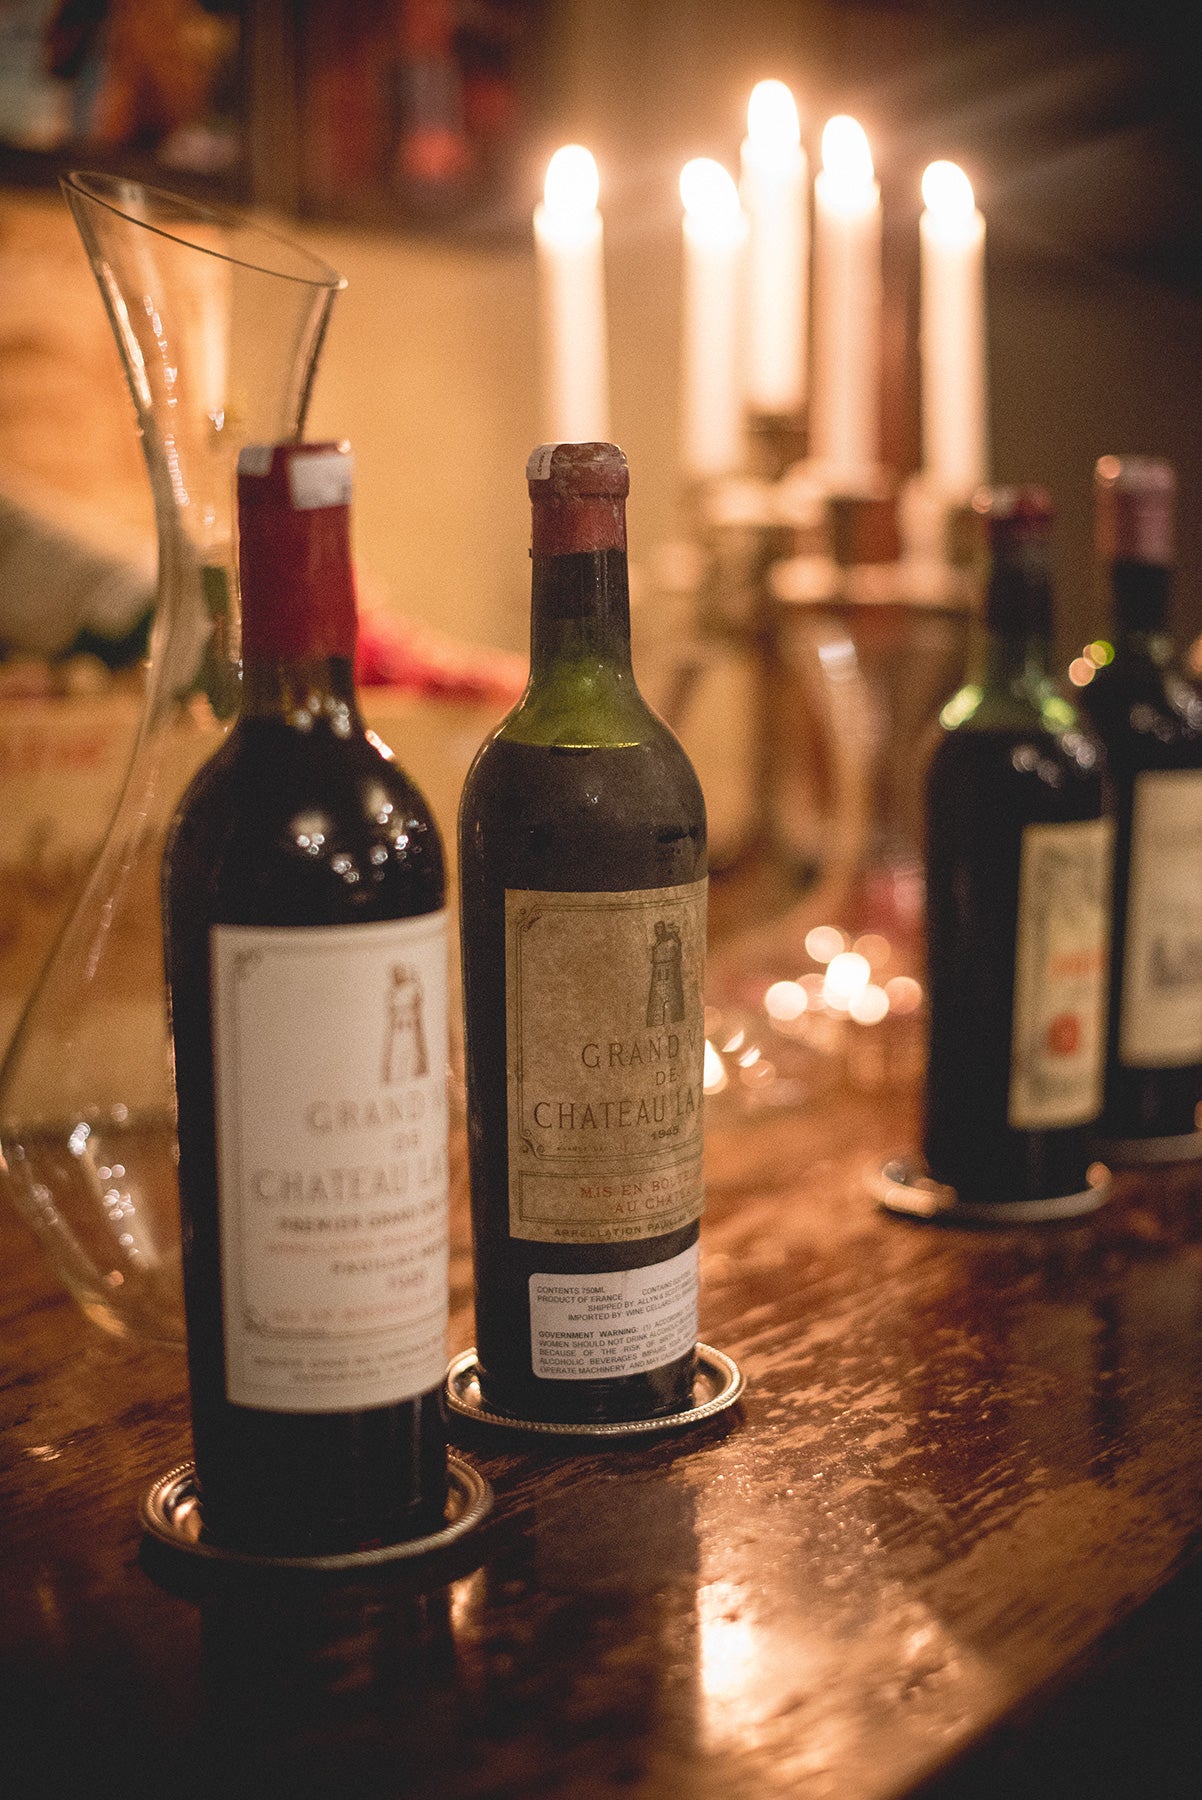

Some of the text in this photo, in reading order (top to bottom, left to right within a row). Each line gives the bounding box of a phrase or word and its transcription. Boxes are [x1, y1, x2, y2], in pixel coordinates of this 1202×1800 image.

[581, 1034, 680, 1069] GRAND
[655, 1067, 679, 1086] DE
[303, 1090, 426, 1134] GRAND
[533, 1093, 666, 1130] CHATEAU
[251, 1163, 408, 1204] CHATEAU
[580, 1186, 613, 1199] MIS
[622, 1183, 643, 1198] EN
[614, 1201, 637, 1214] AU
[554, 1224, 641, 1238] APPELLATION
[537, 1286, 605, 1295] CONTENTS 750ML
[537, 1295, 575, 1303] PRODUCT
[591, 1294, 623, 1302] FRANCE
[588, 1302, 622, 1311] SHIPPED
[638, 1295, 658, 1305] ALLYN
[626, 1307, 644, 1316] WINE
[538, 1331, 594, 1339] GOVERNMENT
[539, 1340, 569, 1348] WOMEN
[572, 1340, 605, 1348] SHOULD
[608, 1337, 624, 1347] NOT
[626, 1334, 648, 1344] DRINK
[540, 1348, 576, 1356] BECAUSE
[601, 1347, 616, 1355] THE
[624, 1344, 640, 1353] RISK
[540, 1358, 584, 1366] ALCOHOLIC
[590, 1353, 637, 1365] BEVERAGES
[540, 1366, 577, 1374] OPERATE
[630, 1360, 645, 1369] AND
[646, 1356, 660, 1366] MAY
